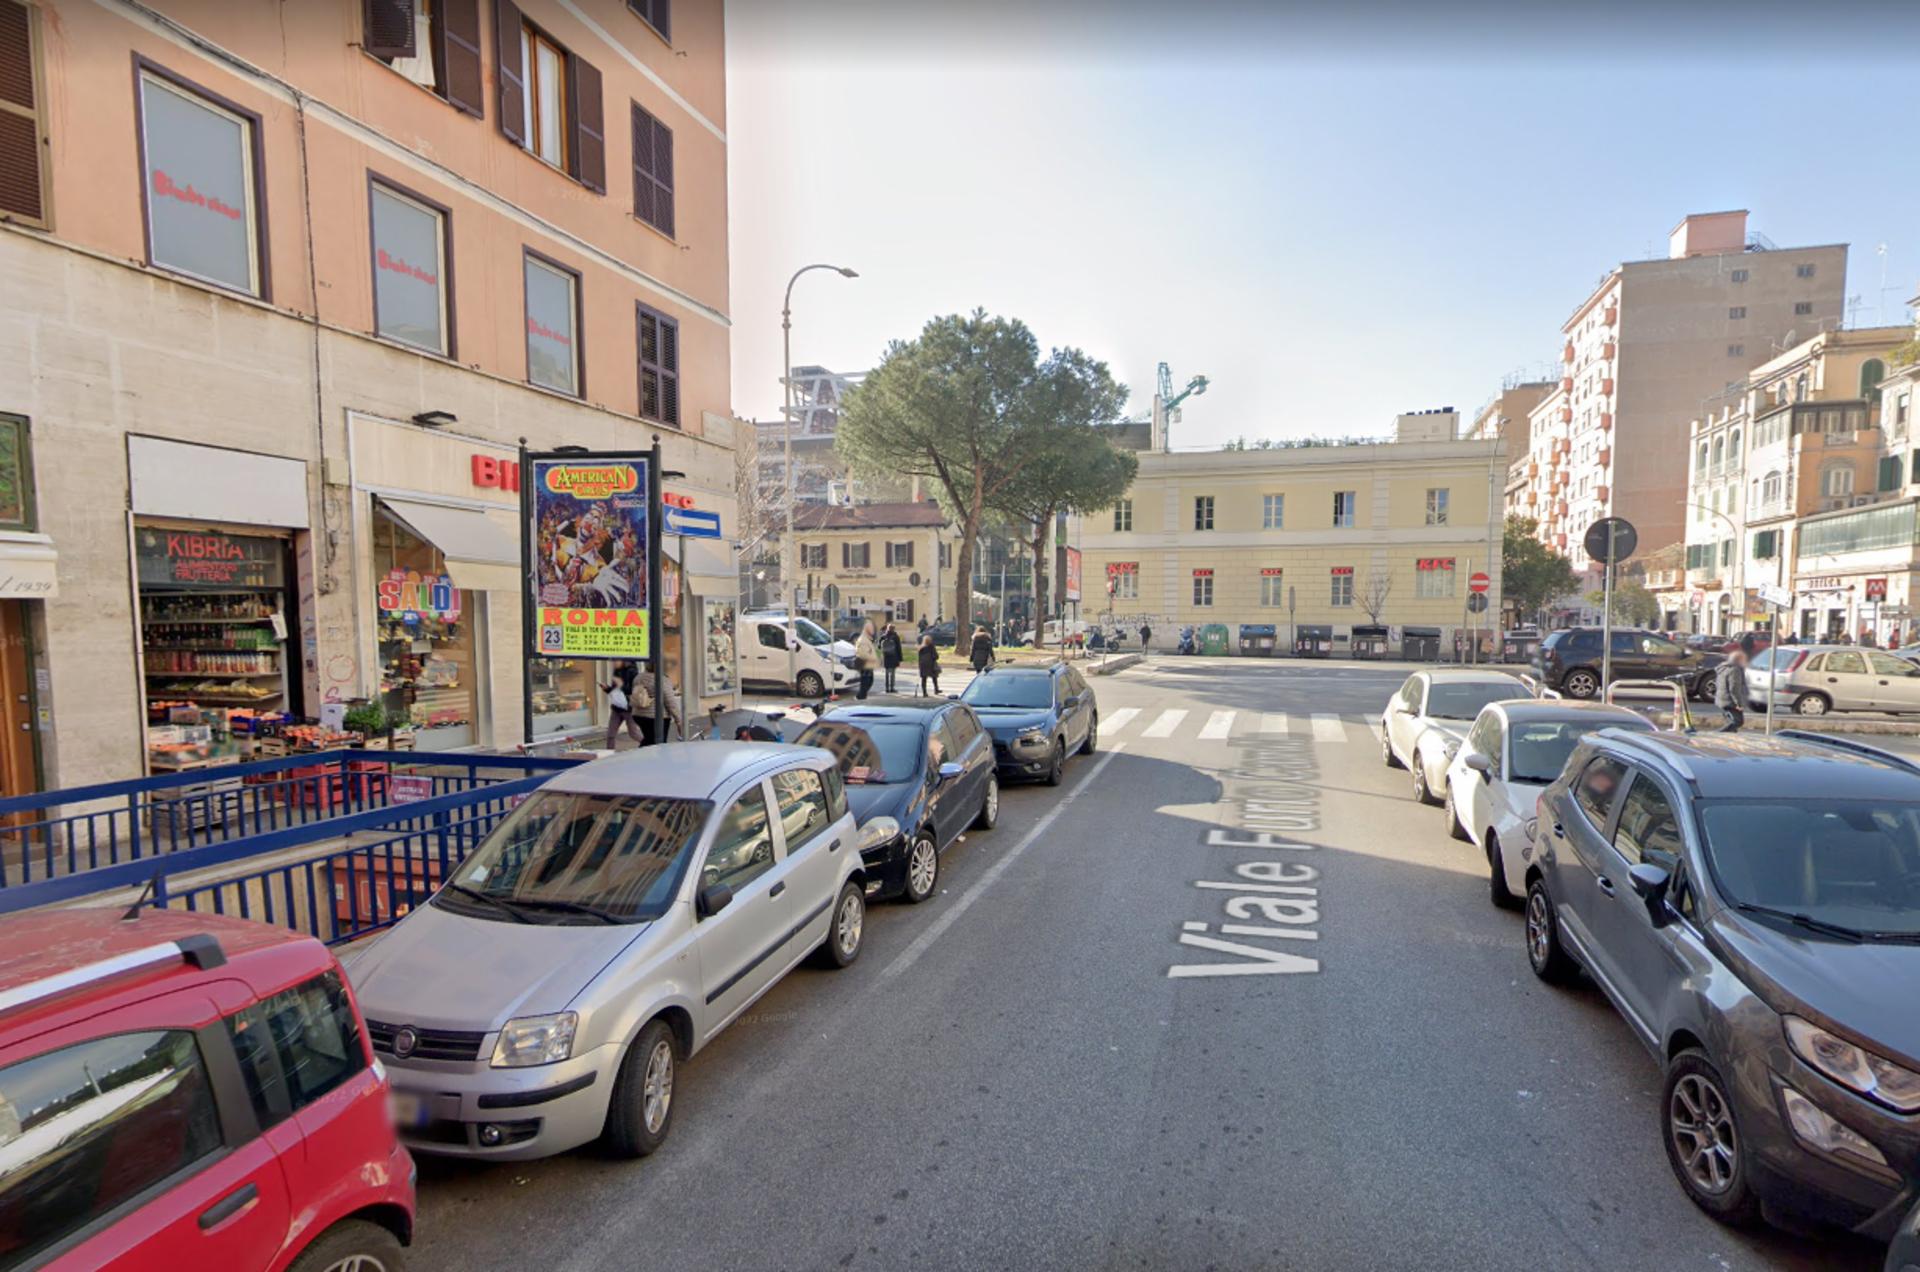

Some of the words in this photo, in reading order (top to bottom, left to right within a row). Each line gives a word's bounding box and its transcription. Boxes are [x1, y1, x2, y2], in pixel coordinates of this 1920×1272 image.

[166, 533, 244, 560] KIBRIA
[378, 580, 462, 614] SALDI
[543, 608, 643, 626] ROMA
[545, 630, 561, 644] 23
